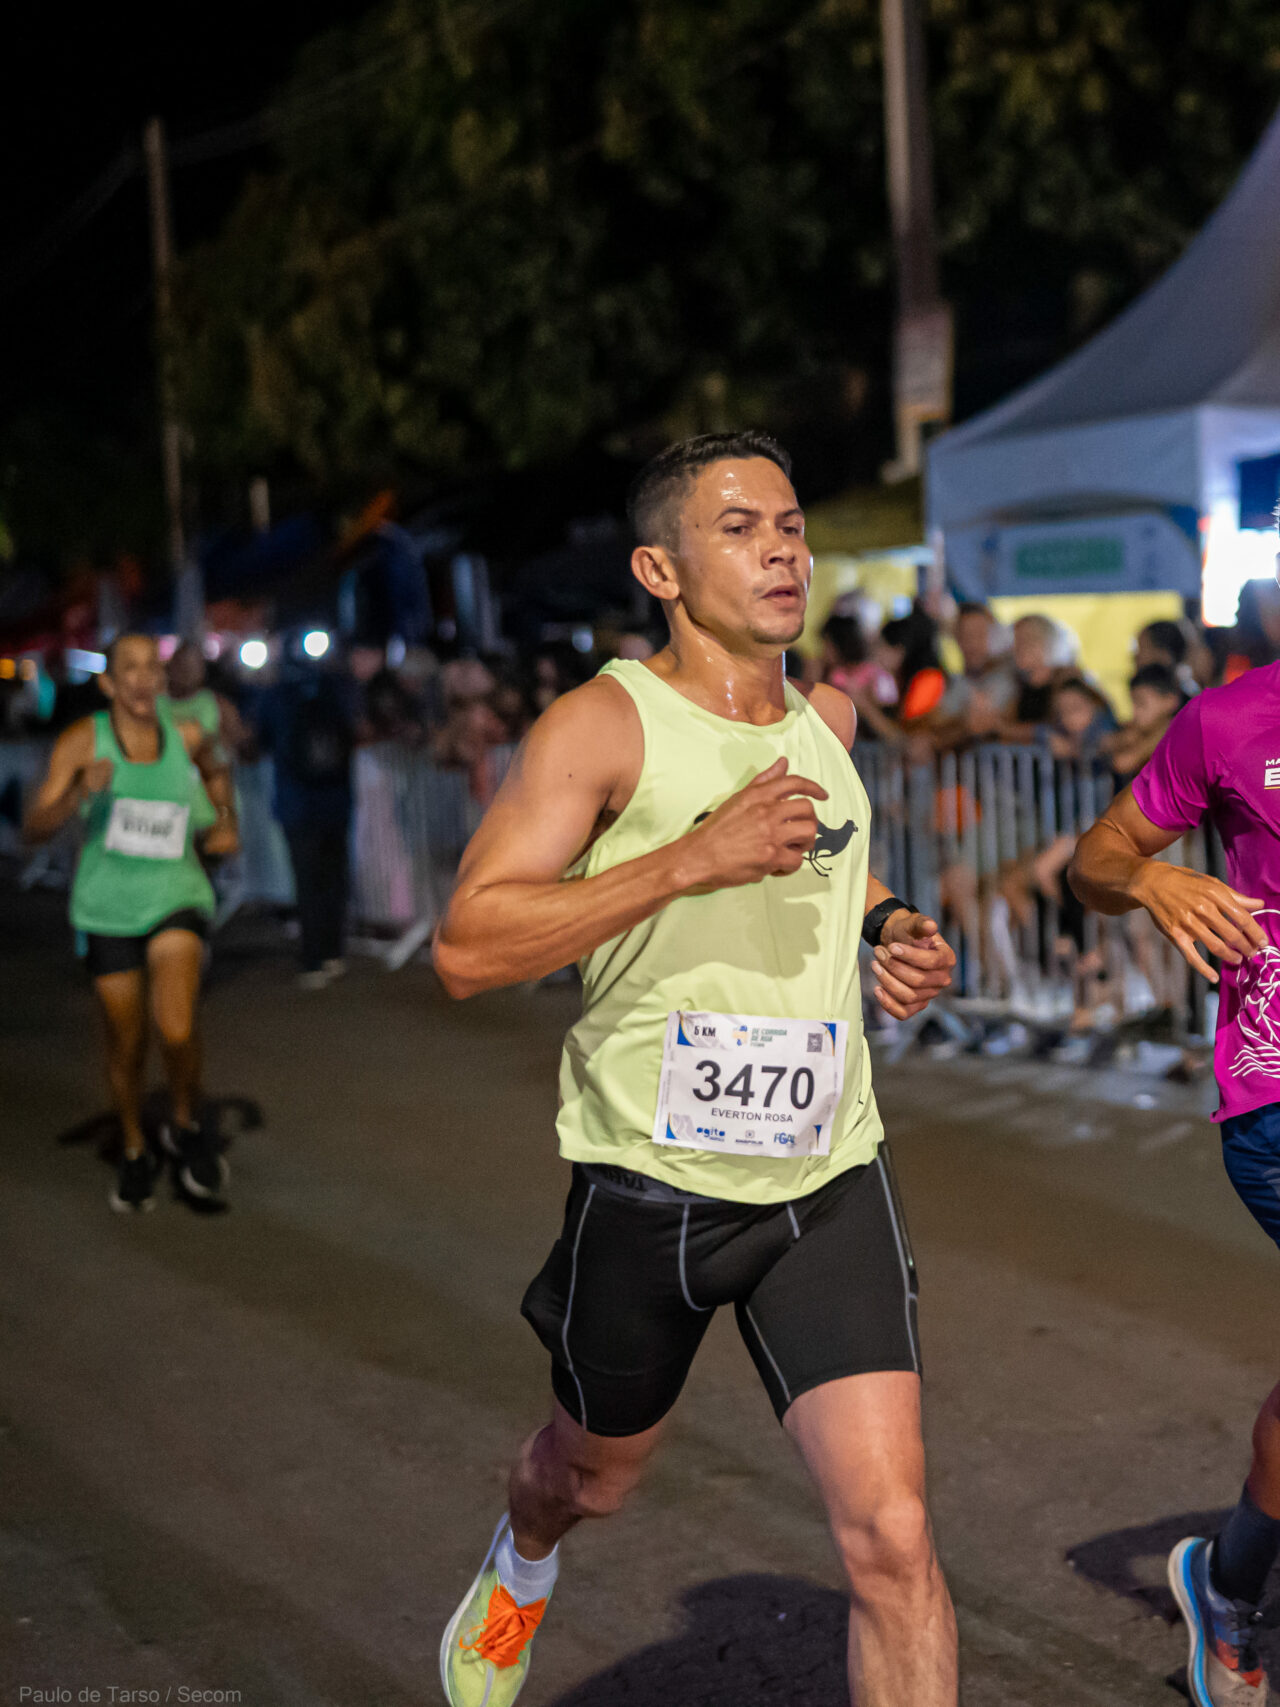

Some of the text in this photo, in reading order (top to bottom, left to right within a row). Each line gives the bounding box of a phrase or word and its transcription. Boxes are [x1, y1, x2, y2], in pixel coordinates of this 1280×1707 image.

[694, 1025, 716, 1037] 5 KM
[692, 1059, 815, 1110] 3470
[711, 1107, 793, 1123] EVERTON ROSA
